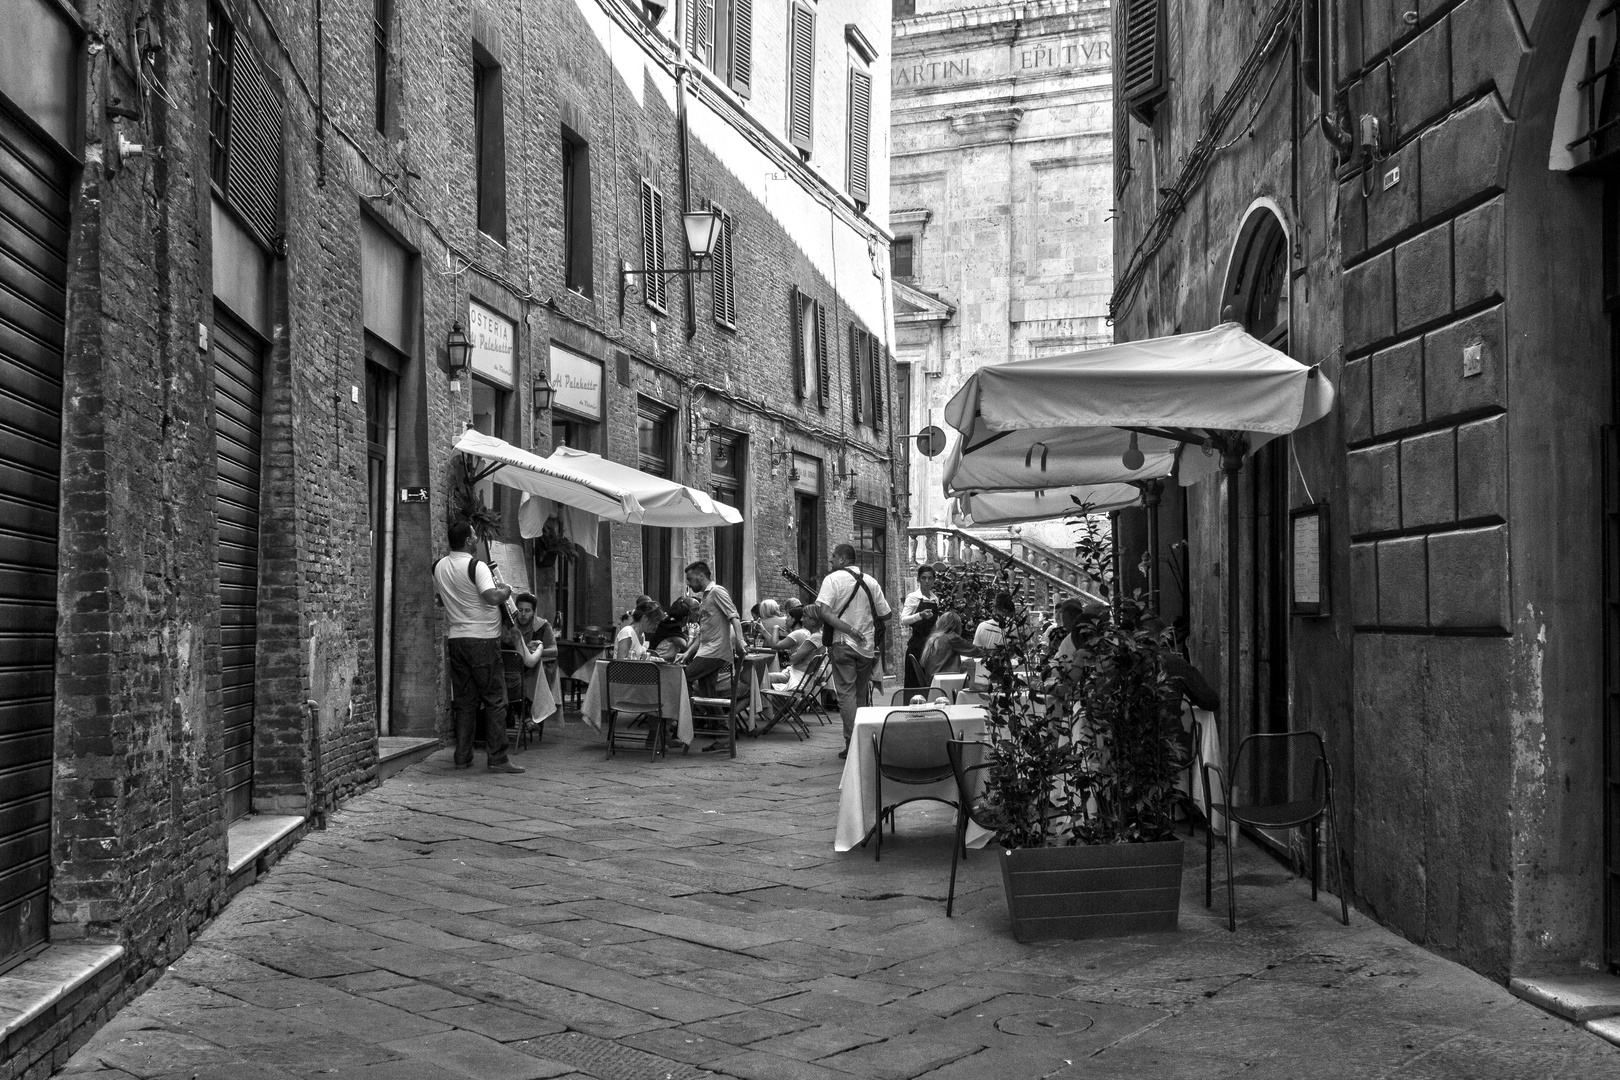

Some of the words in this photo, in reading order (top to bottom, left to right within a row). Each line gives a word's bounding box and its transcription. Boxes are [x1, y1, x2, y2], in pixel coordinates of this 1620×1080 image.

[890, 58, 970, 86] ARTINI
[470, 309, 508, 341] OSTERIA
[479, 332, 513, 355] Palchetto
[552, 372, 562, 388] Al
[564, 373, 598, 391] Palchetto
